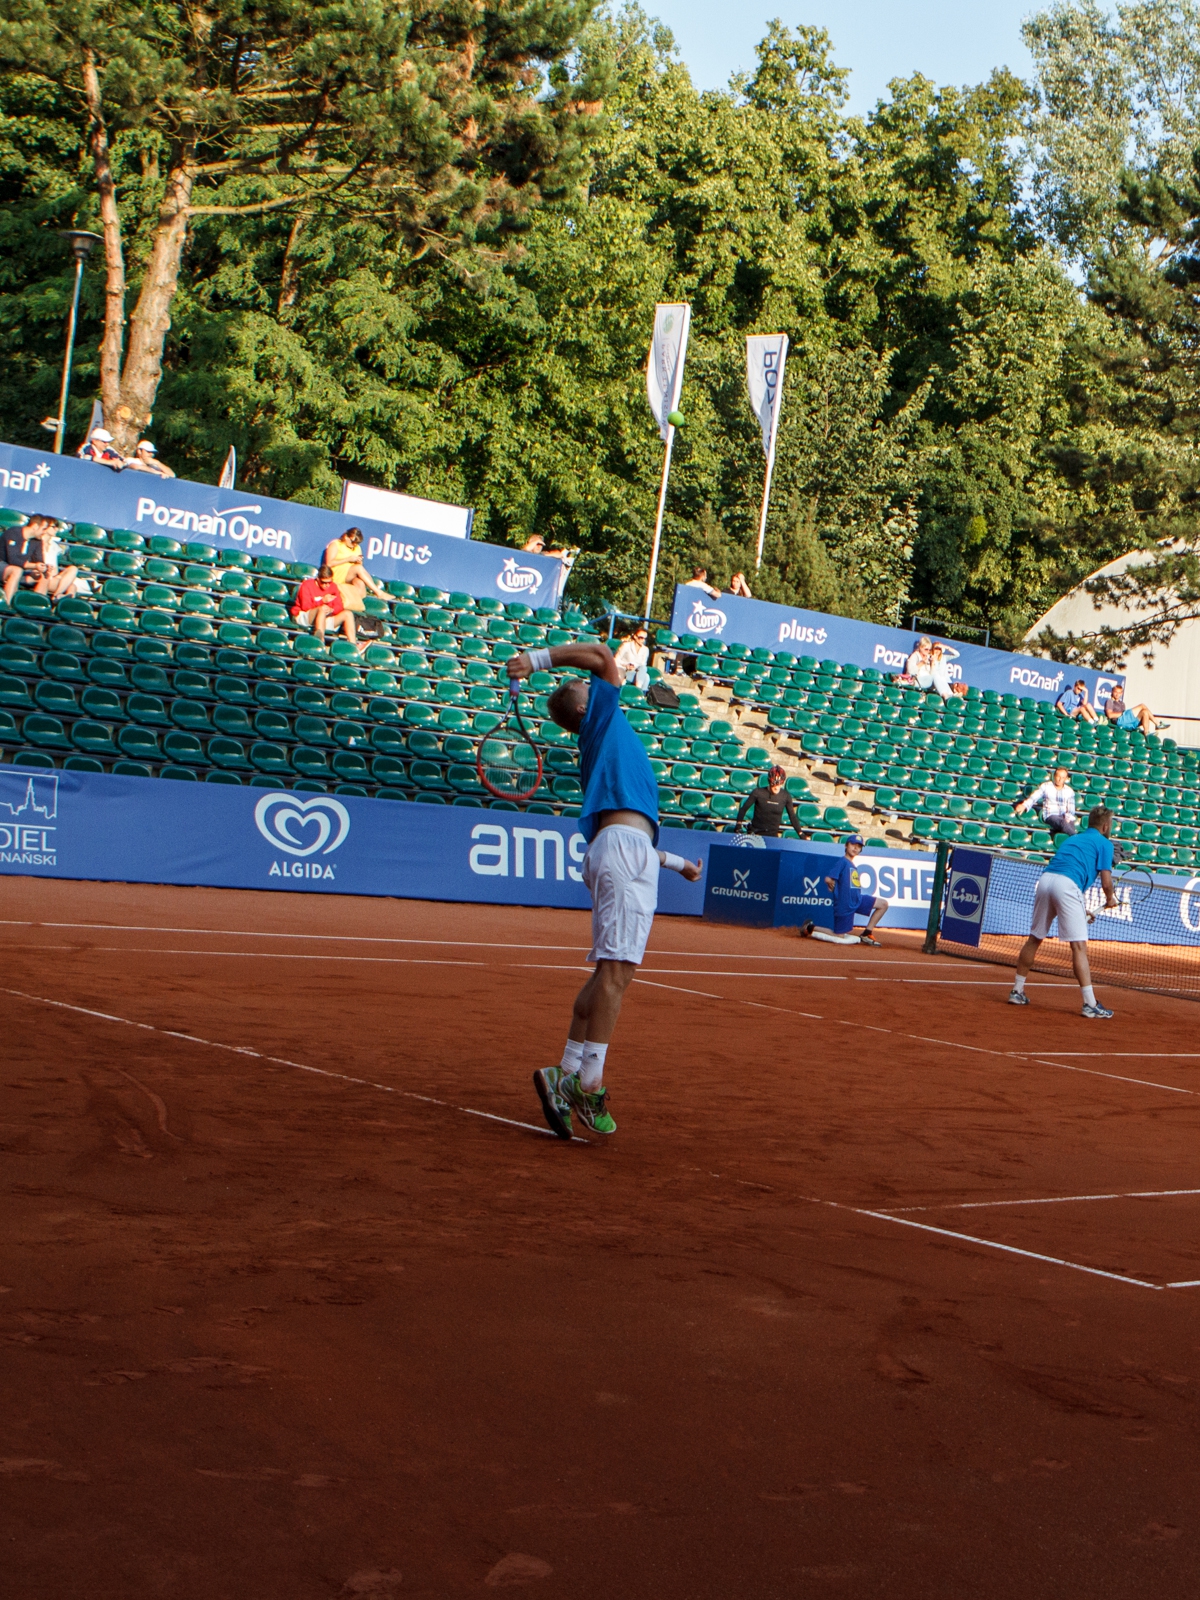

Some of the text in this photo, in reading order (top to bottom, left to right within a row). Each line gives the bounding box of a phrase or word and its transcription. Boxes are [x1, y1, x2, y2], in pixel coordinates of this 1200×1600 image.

[367, 533, 415, 561] plus
[506, 572, 534, 588] LOTTO
[695, 613, 720, 628] LOTTO
[778, 619, 814, 643] plus
[0, 825, 57, 852] OTEL
[0, 851, 57, 866] NAŃSKI
[268, 861, 335, 880] ALGIDA
[711, 886, 769, 902] GRUNDFOS
[781, 895, 833, 907] GRUNDFO
